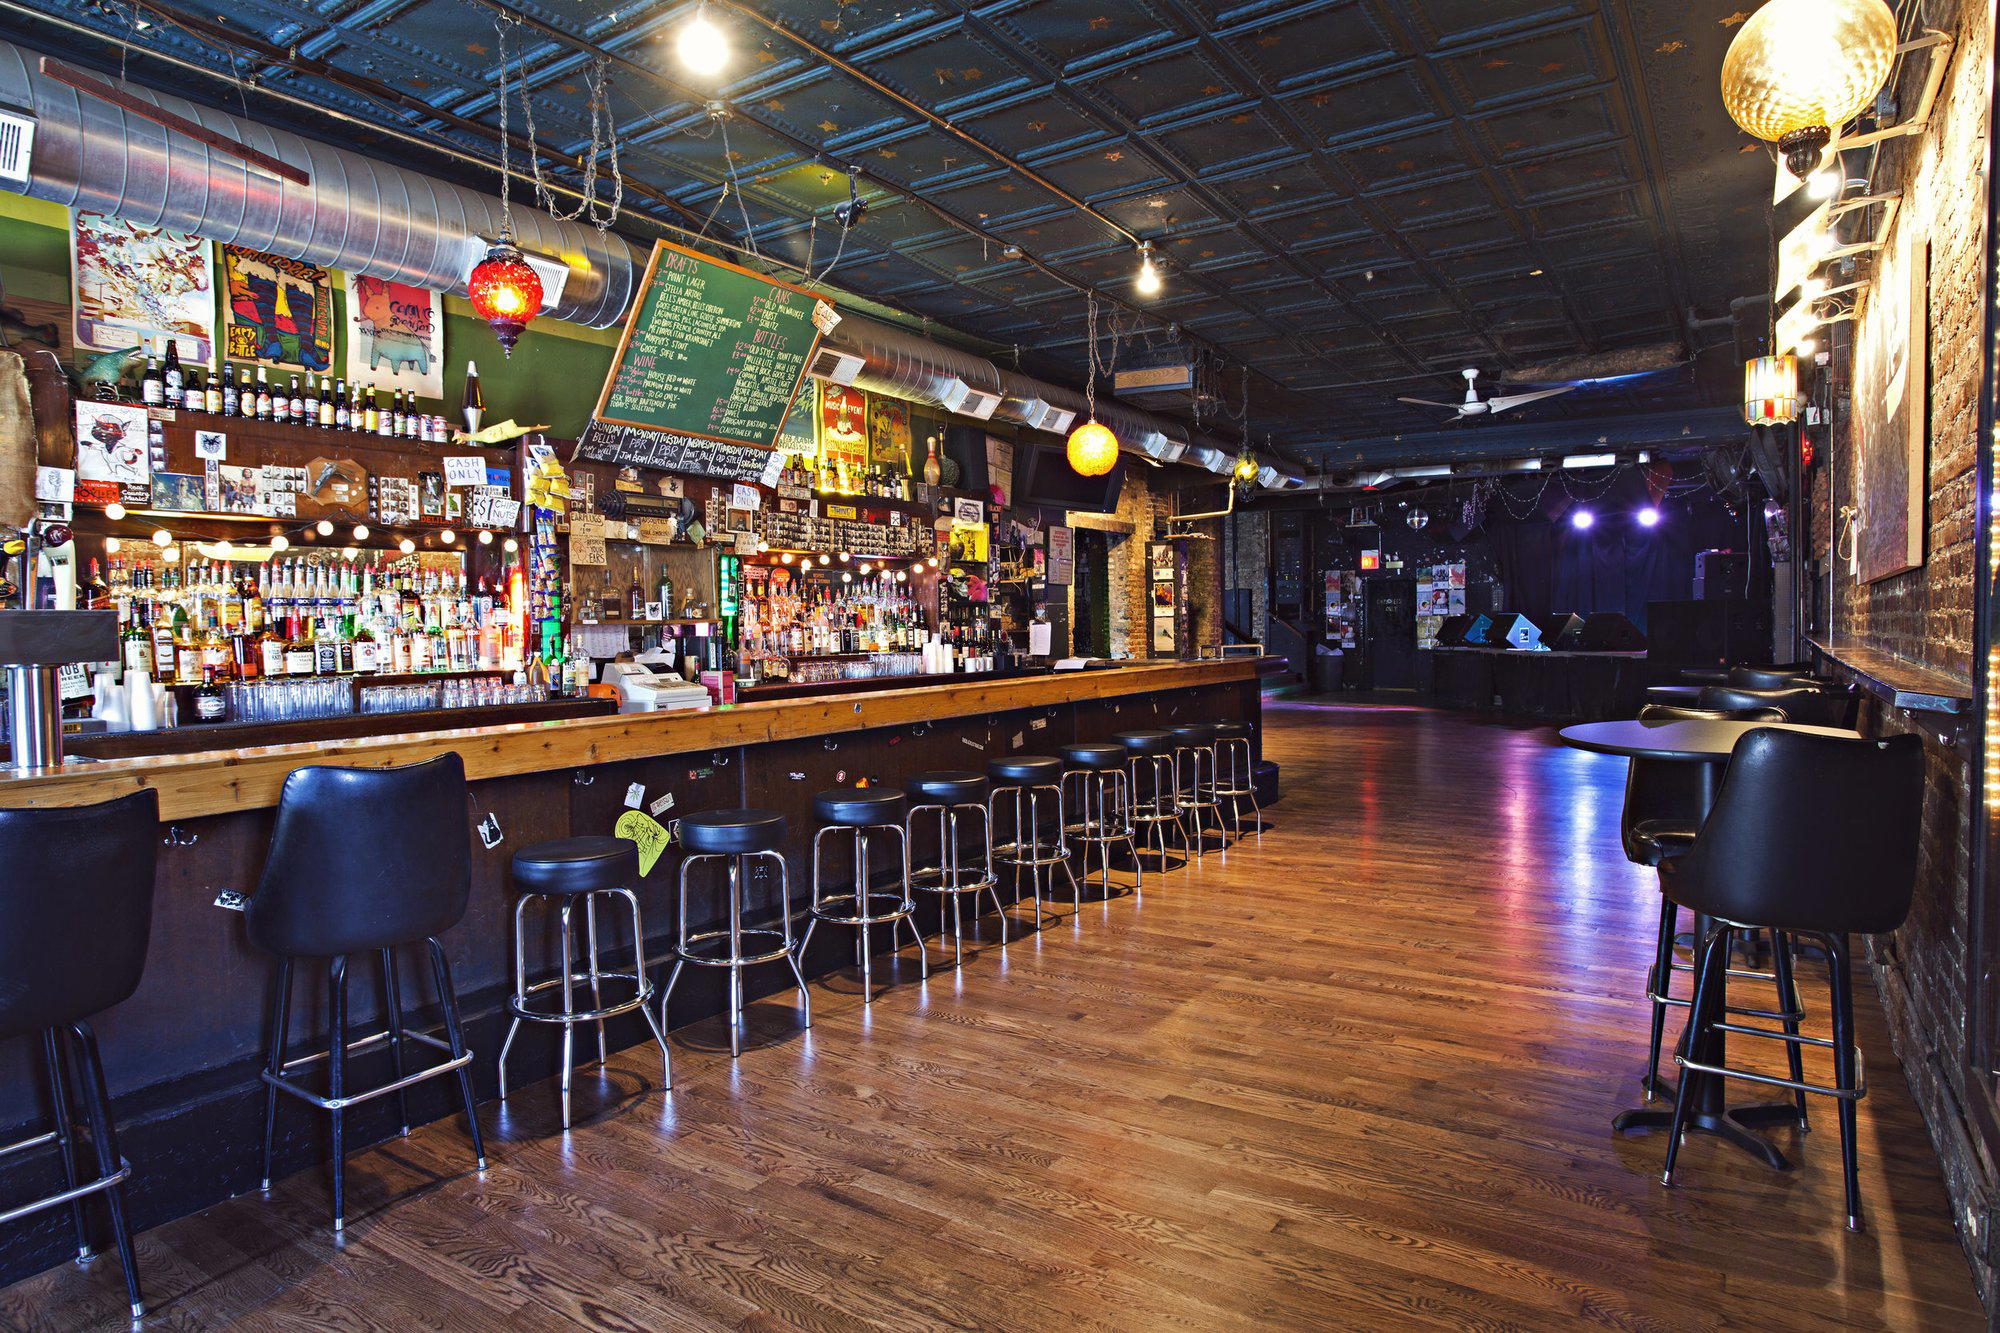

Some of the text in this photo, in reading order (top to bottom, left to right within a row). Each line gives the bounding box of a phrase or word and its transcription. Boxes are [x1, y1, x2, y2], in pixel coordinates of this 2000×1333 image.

[665, 252, 700, 274] DRAFTS
[667, 271, 686, 284] POINT
[686, 276, 706, 290] LAGER
[663, 283, 682, 296] STELLA
[768, 287, 793, 305] CANS
[761, 309, 778, 321] PABST
[229, 327, 256, 341] EMPTY
[753, 328, 788, 351] BOTTLES
[229, 341, 256, 357] BOTTLE
[633, 353, 658, 369] WINE
[647, 370, 666, 383] HOUSE
[847, 405, 864, 415] EVENT
[592, 420, 624, 436] SUNDAY
[626, 427, 658, 442] MONDAY
[629, 438, 648, 449] PBR
[660, 432, 688, 446] TUESDAY
[658, 444, 679, 457] PBR
[745, 448, 769, 459] FRIDAY
[447, 458, 479, 468] CASH
[620, 451, 650, 464] JIM BEAM
[726, 455, 740, 464] STYLE
[448, 469, 480, 481] ONLY
[736, 486, 758, 496] CASH
[494, 499, 518, 511] CHIPS
[736, 496, 756, 507] ONLY
[477, 498, 494, 521] $1
[492, 509, 515, 520] NUTS
[570, 513, 602, 523] EARPLUGS
[588, 553, 605, 564] EARS
[60, 663, 79, 677] NOB
[61, 674, 85, 682] REEK
